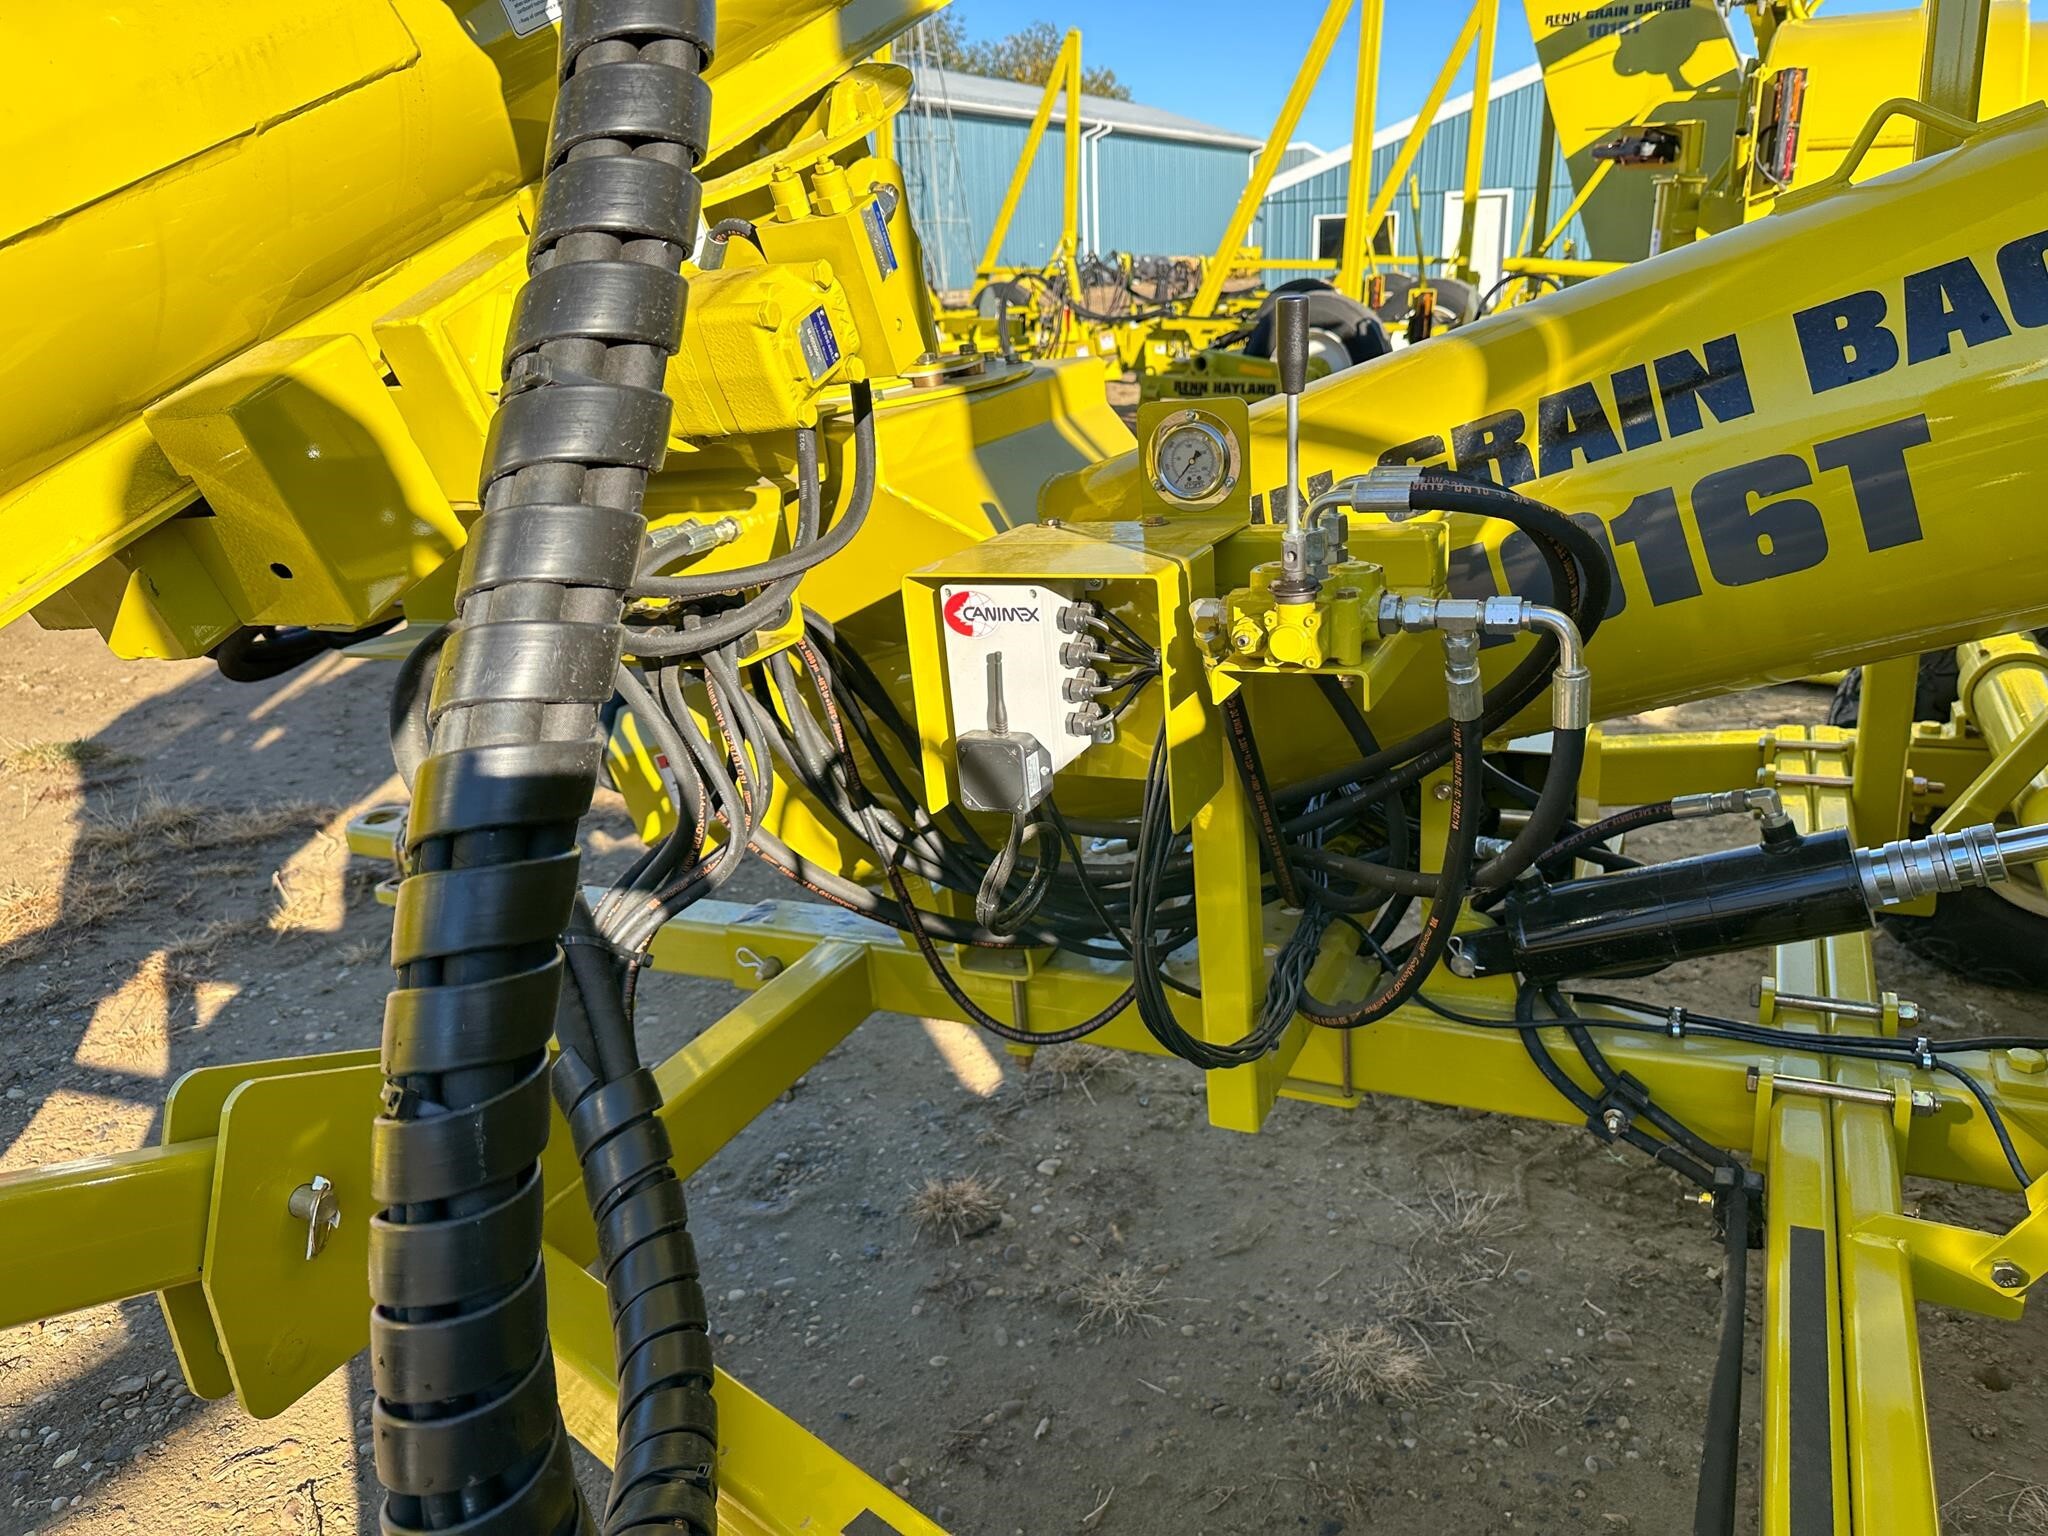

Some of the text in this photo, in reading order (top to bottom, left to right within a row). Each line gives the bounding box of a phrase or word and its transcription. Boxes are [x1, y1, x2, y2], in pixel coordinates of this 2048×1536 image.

[1545, 12, 1580, 27] RENN
[1585, 5, 1628, 20] GRAIN
[1174, 381, 1276, 396] RENN HAYLAND
[1447, 413, 1931, 652] 1016T
[963, 606, 1040, 622] CANIMEX
